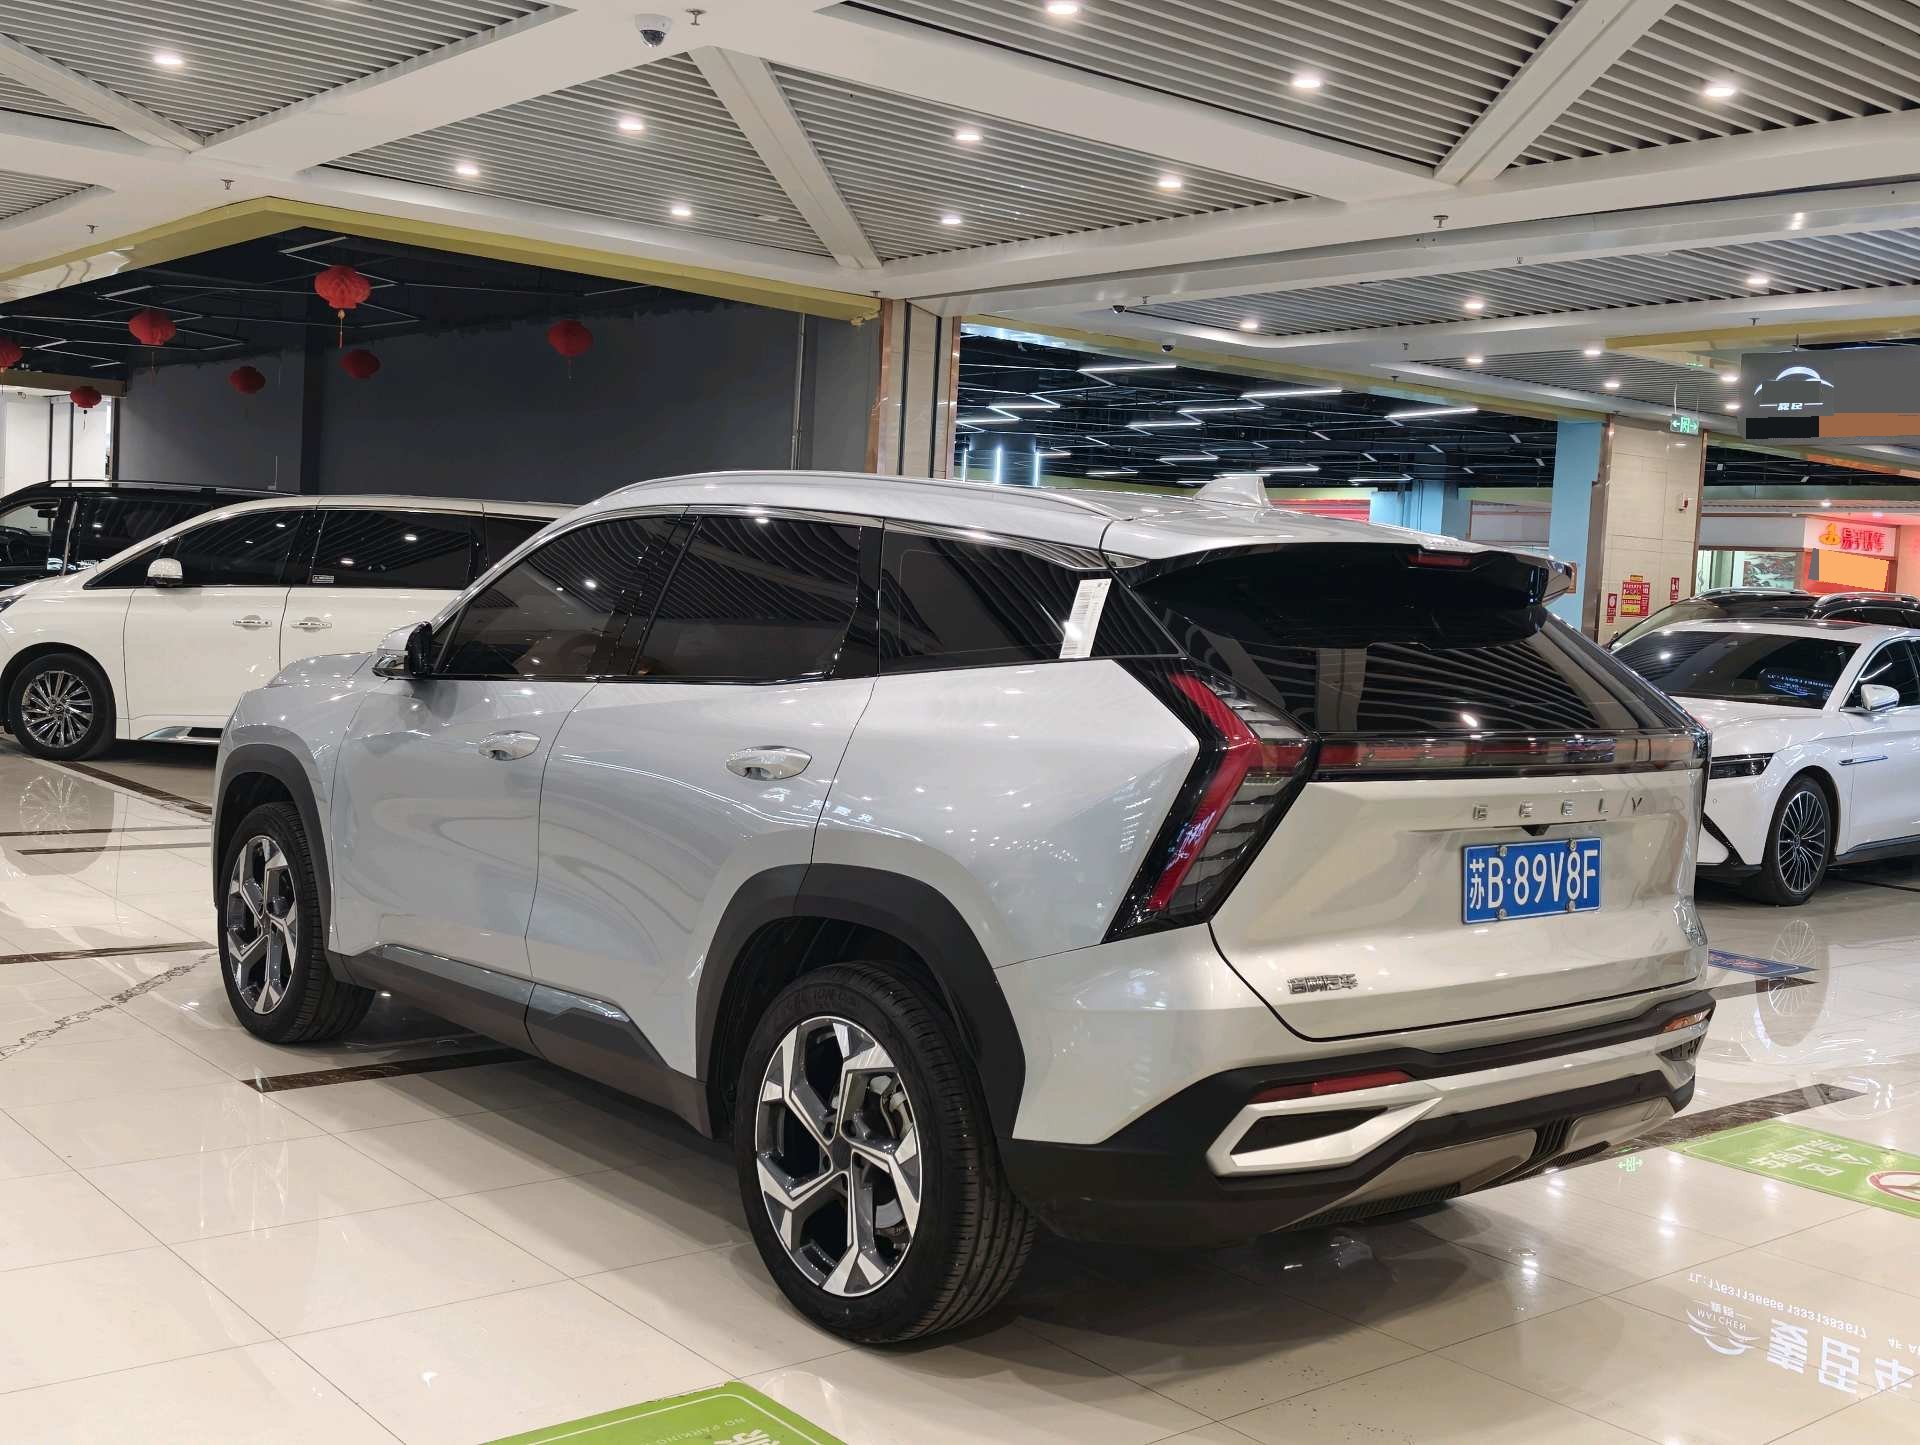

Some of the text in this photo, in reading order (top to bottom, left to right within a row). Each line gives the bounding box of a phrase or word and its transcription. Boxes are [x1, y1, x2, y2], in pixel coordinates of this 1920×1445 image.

[1473, 797, 1642, 820] GEELY
[1747, 1139, 1848, 1169] 禁止停车
